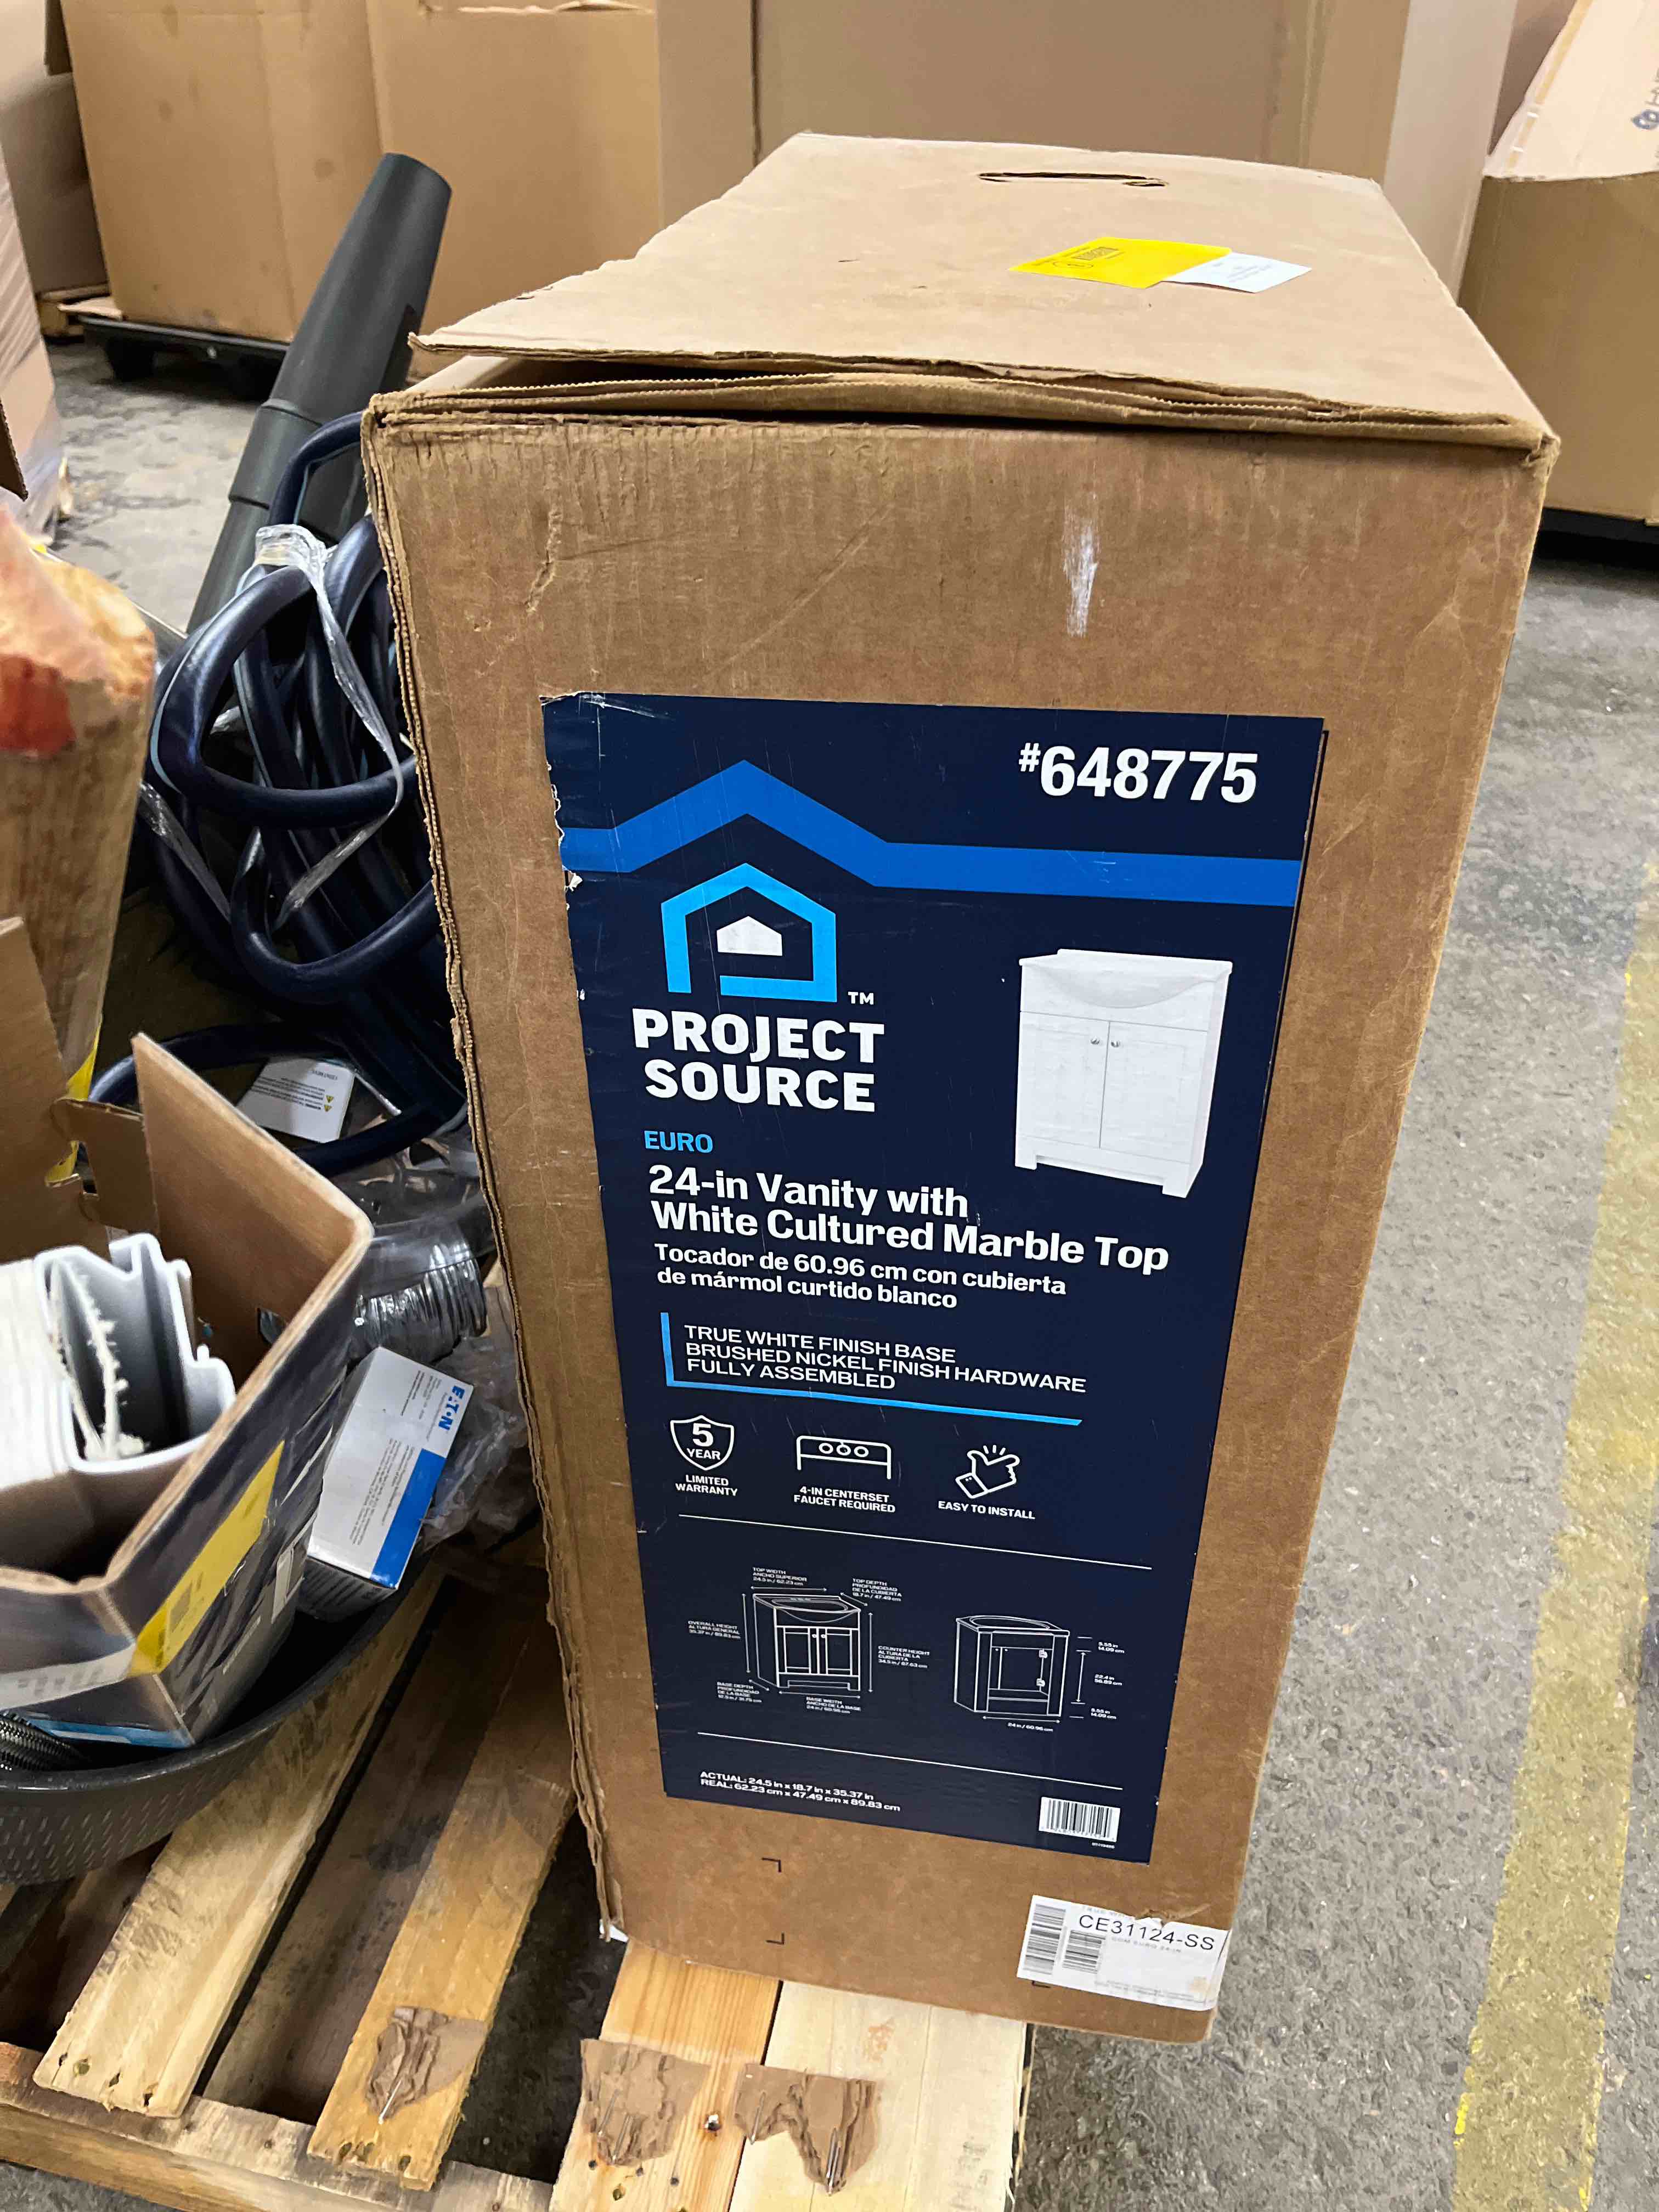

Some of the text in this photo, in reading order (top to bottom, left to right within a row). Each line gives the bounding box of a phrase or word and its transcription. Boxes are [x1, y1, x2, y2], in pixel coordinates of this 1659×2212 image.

[1019, 743, 1257, 803] #648775
[633, 1008, 884, 1063] PROJECT
[645, 1059, 874, 1111] SOURCE
[644, 1131, 713, 1153] EURO
[650, 1165, 968, 1217] 24-in Vanity with
[651, 1201, 1168, 1275] White Cultured Marble Top
[654, 1244, 1066, 1294] Tocador de 60.96 cm con cubierta
[658, 1267, 957, 1308] de mármol curtido blanco
[684, 1325, 955, 1363] TRUE WHITE FINISH BASE
[686, 1343, 1086, 1392] BRUSHED NICKEL FINISH HARDWARE
[688, 1359, 895, 1389] FULLY ASSEMBLED
[693, 1423, 713, 1446] 5
[687, 1448, 721, 1460] YEAR
[675, 1483, 737, 1496] WARRANTY
[686, 1475, 729, 1486] LIMITED
[799, 1486, 889, 1504] 4-IN CENTERSET
[794, 1495, 895, 1513] FAUCET REQUIRED
[939, 1501, 1035, 1519] EASY TO INSTALL
[701, 1771, 747, 1783] ACTUAL:
[748, 1778, 772, 1787] 24.5
[833, 1789, 862, 1798] 35.37
[701, 1779, 732, 1788] REAL:
[734, 1783, 765, 1793] 62.23
[792, 1791, 823, 1801] 47.49
[851, 1799, 882, 1808] 89.83
[1079, 1915, 1215, 1950] CE31124-SS
